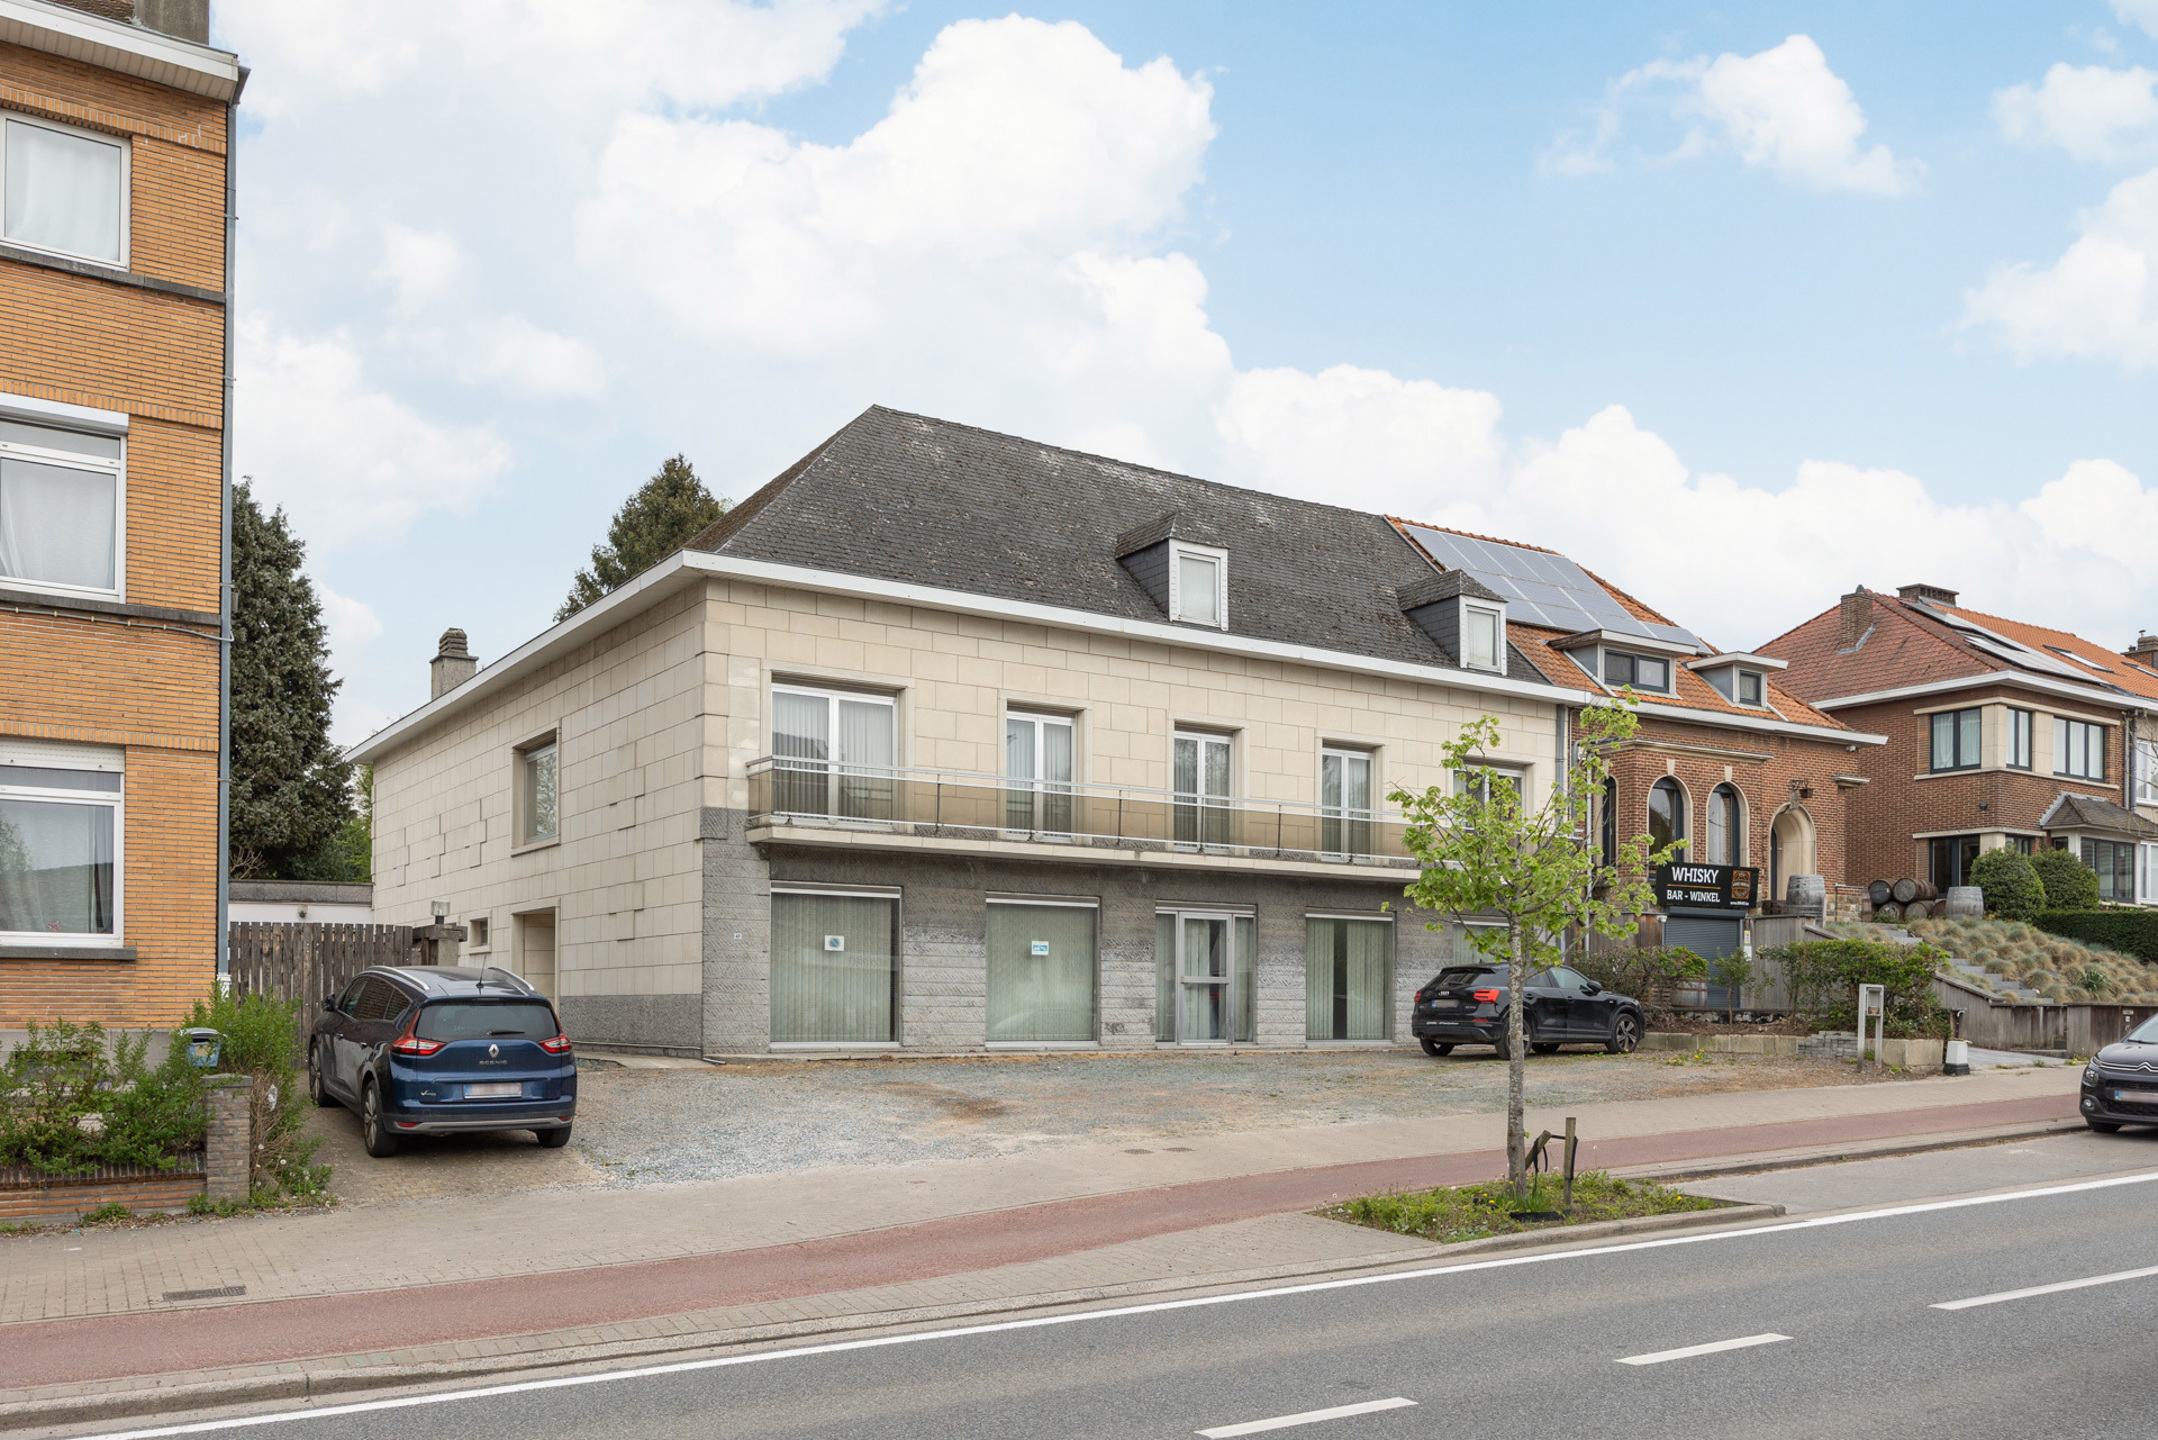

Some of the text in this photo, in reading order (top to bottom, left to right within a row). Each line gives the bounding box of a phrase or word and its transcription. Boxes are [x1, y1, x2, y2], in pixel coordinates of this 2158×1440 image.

[1671, 866, 1719, 883] WHISKY
[1667, 889, 1683, 901] BAR
[1690, 890, 1720, 903] WINKEL
